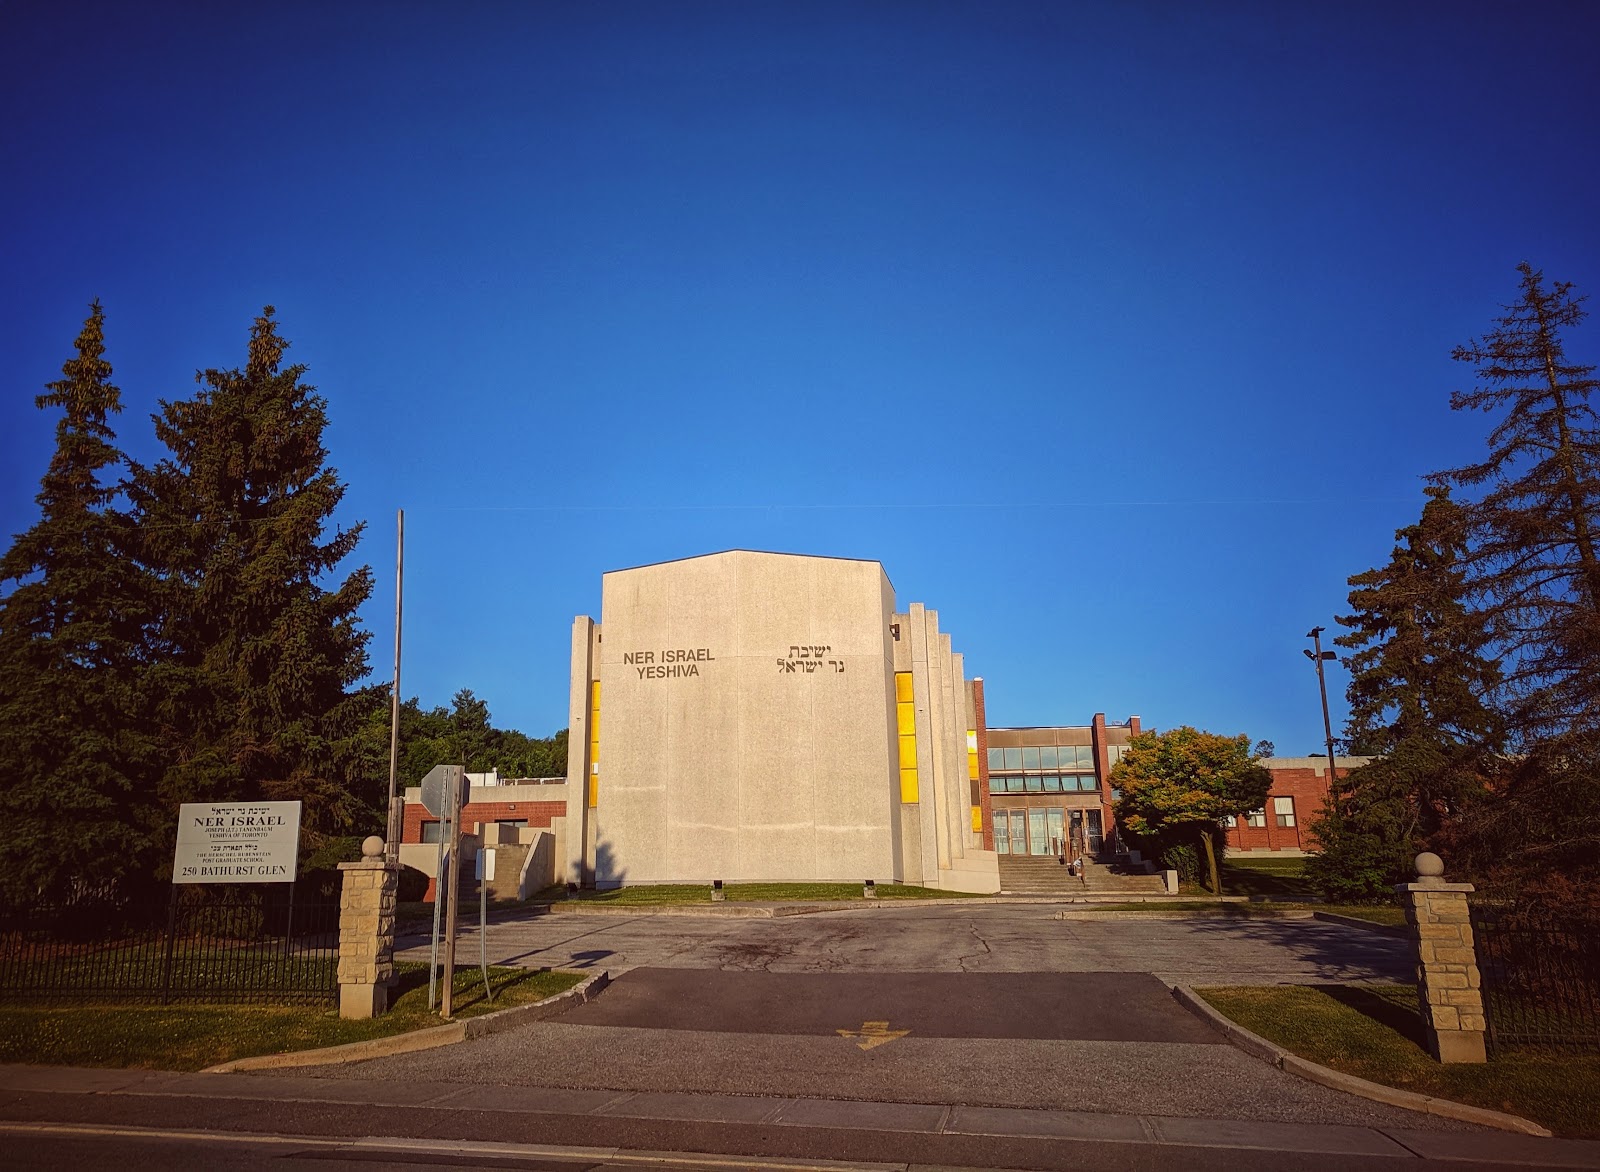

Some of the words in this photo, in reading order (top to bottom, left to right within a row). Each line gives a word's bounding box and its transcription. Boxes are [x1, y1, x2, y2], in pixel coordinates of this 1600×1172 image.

[623, 651, 655, 665] NER
[661, 648, 716, 663] ISRAEL
[788, 645, 832, 659] ישיבת
[636, 664, 700, 680] YESHIVA
[776, 658, 823, 674] ישראל
[828, 660, 845, 673] נר
[193, 817, 225, 827] NER
[231, 815, 286, 826] ISRAEL
[182, 867, 197, 876] 250
[201, 866, 255, 876] BATHURST
[258, 865, 287, 875] GLEN
